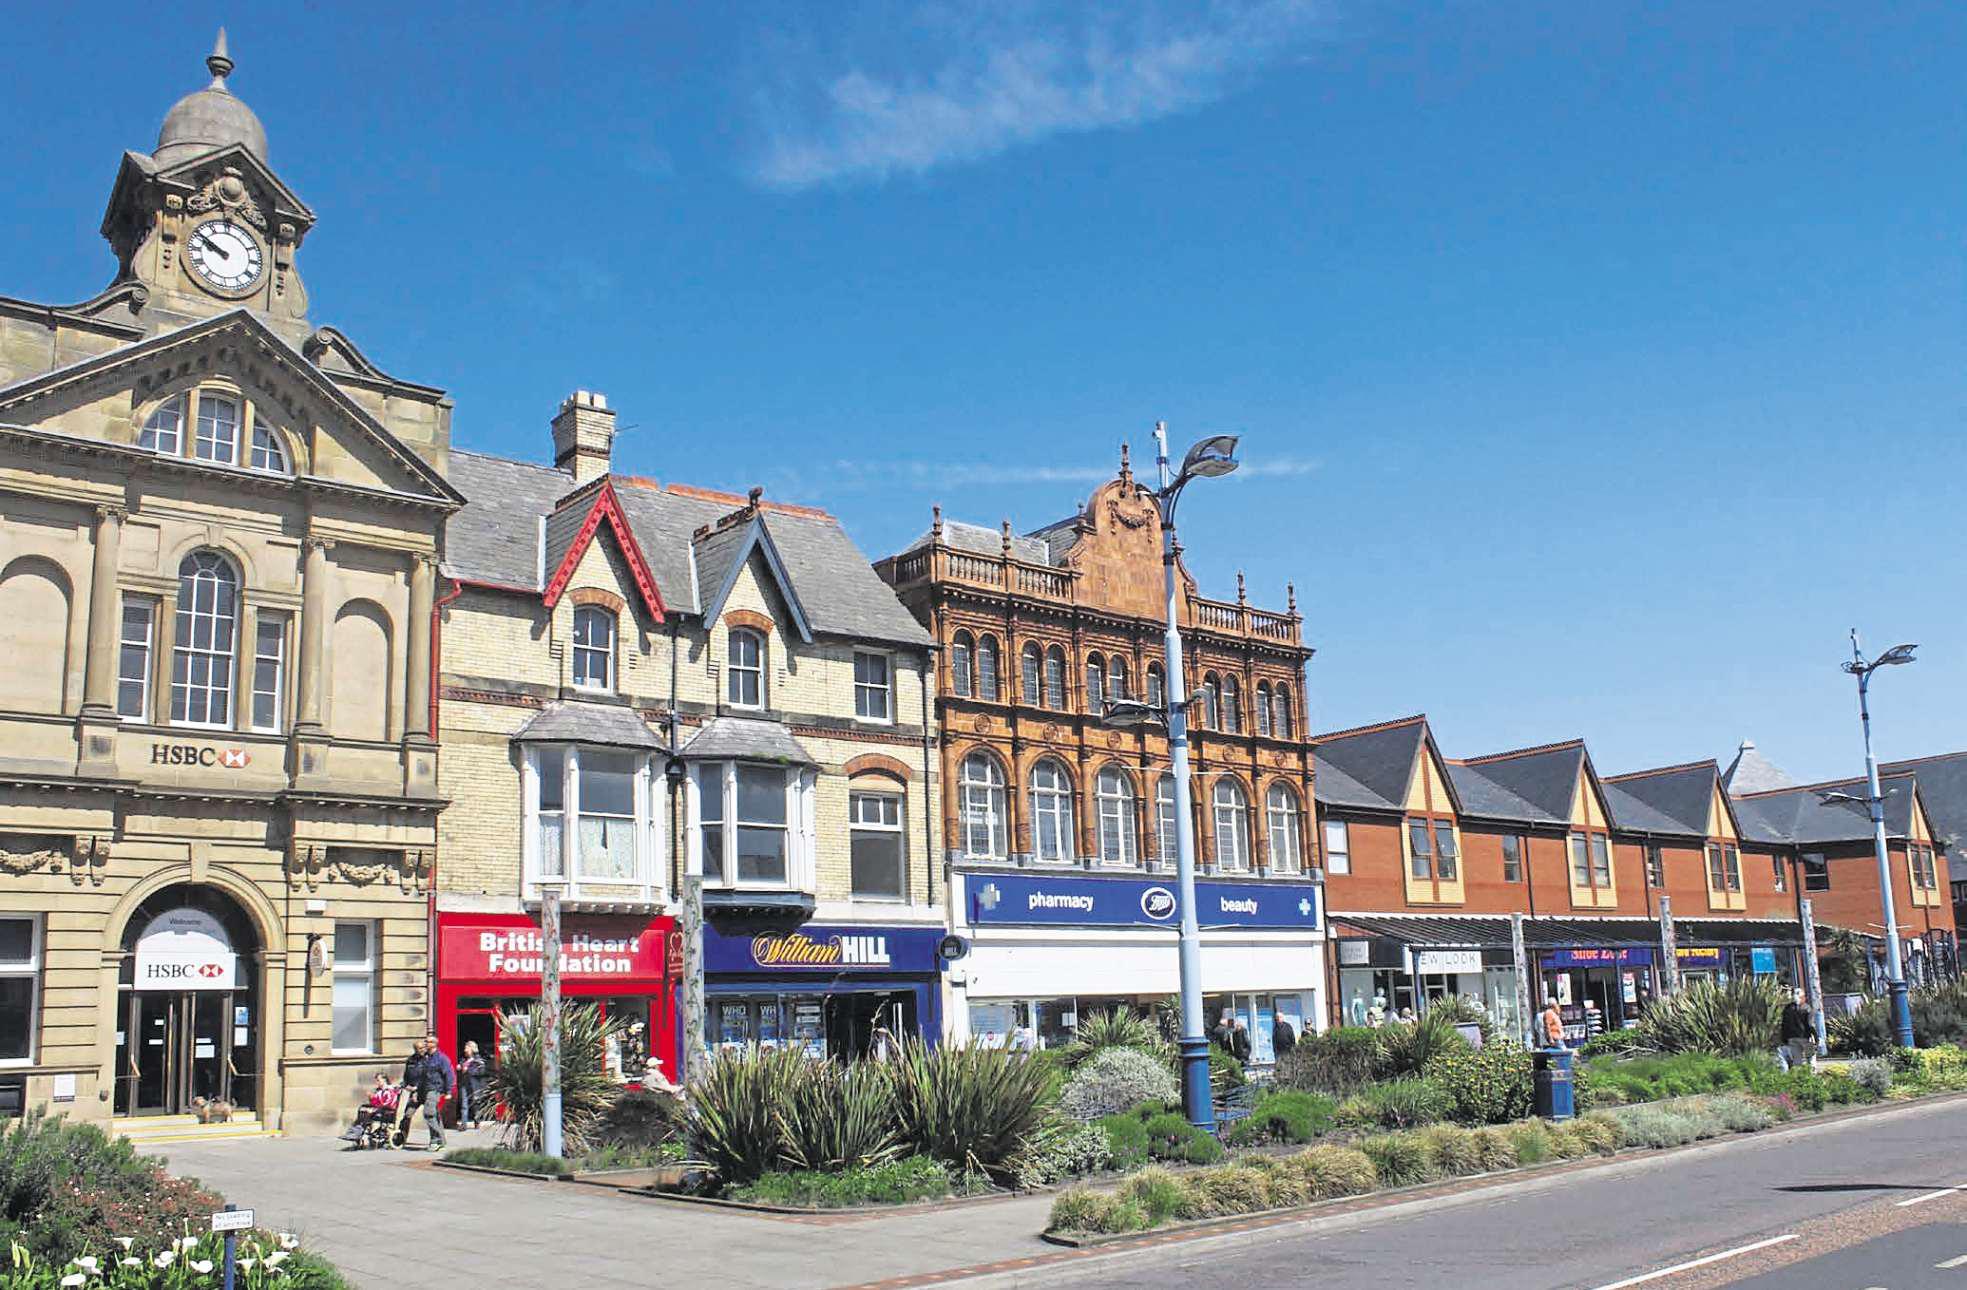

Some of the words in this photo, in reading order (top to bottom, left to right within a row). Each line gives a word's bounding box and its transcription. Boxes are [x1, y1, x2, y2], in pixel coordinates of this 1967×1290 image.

[151, 744, 216, 767] HSBC
[1029, 891, 1094, 912] pharmacy
[1149, 895, 1171, 912] Boots
[1221, 896, 1258, 915] beauty
[480, 932, 562, 952] Britis
[573, 934, 639, 952] Heart
[753, 931, 843, 965] William
[842, 936, 890, 963] HILL
[1419, 953, 1438, 965] EW
[1445, 953, 1476, 965] LOOK
[147, 964, 195, 978] HSBC
